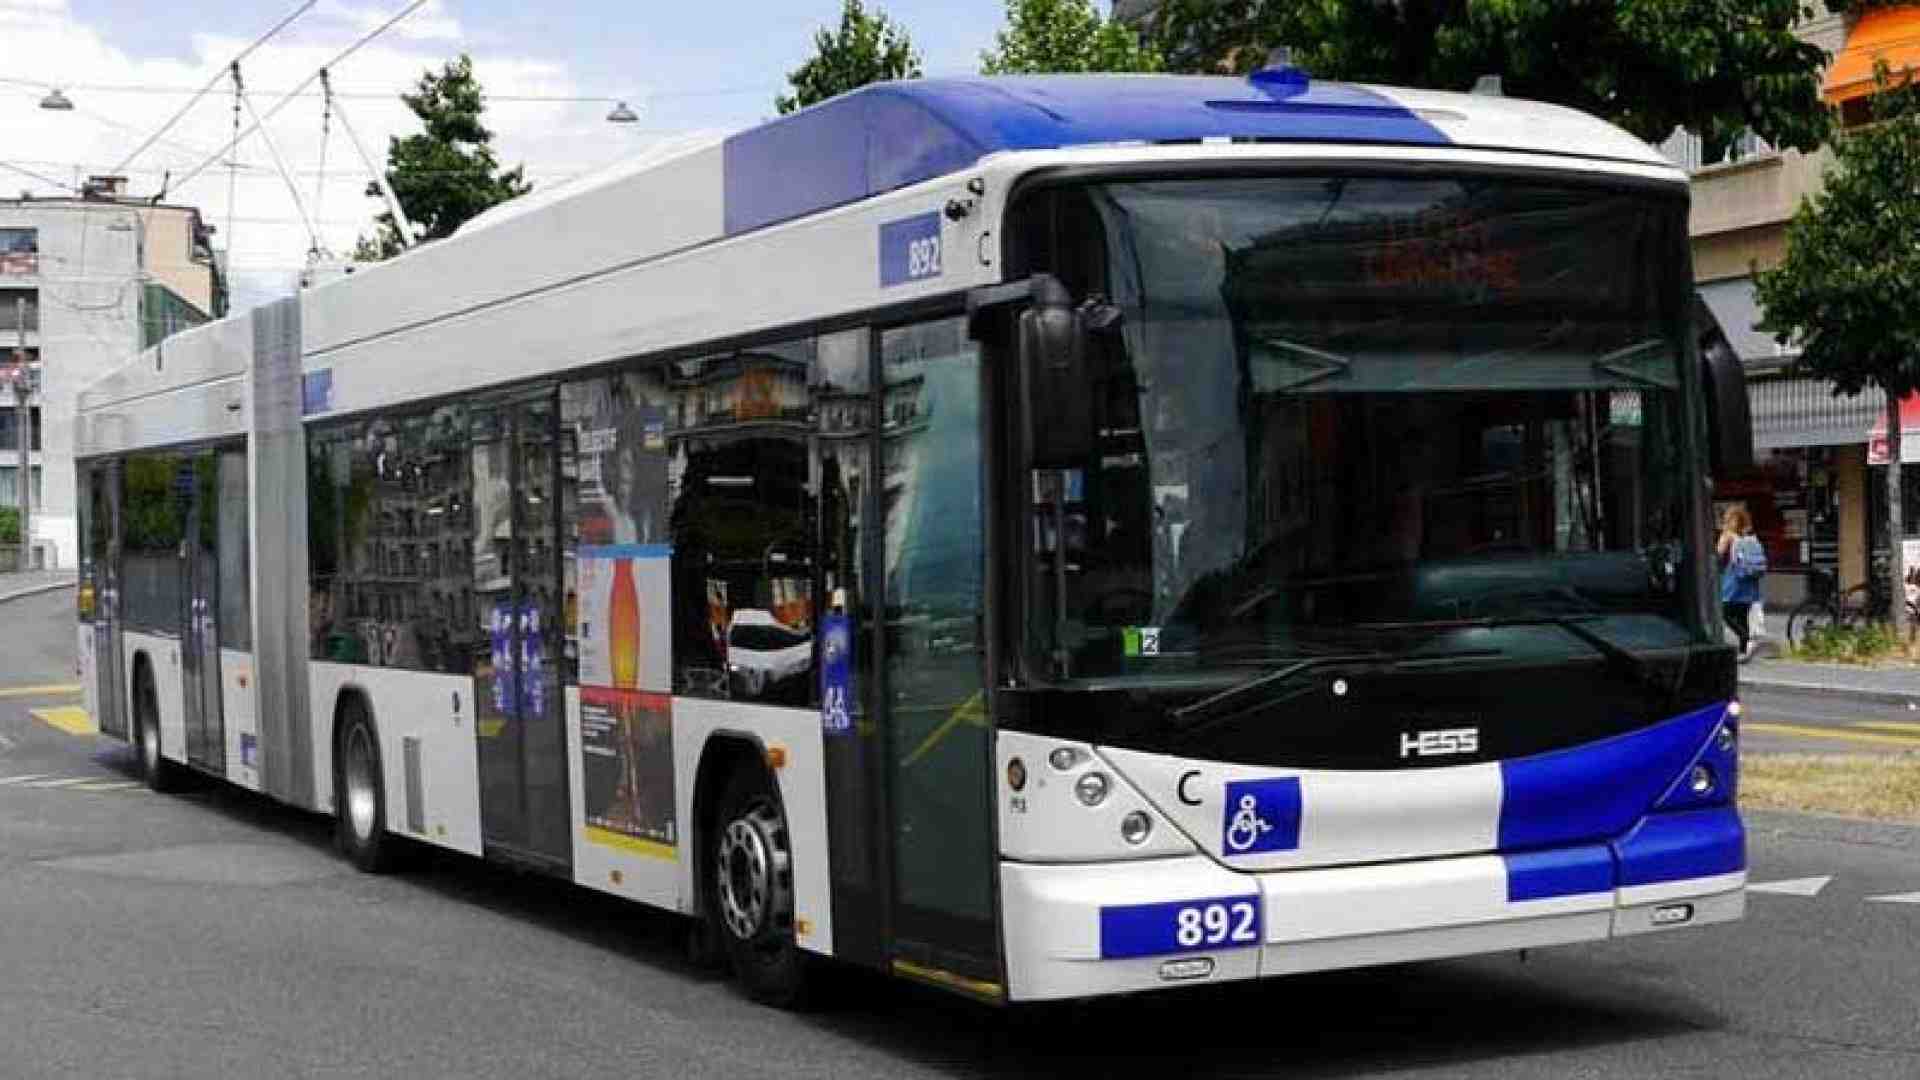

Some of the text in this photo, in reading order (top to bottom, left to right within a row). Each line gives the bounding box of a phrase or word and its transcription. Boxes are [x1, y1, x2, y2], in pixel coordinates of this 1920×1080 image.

[910, 236, 939, 276] 892
[1399, 727, 1478, 758] HESS
[1176, 902, 1257, 946] 892
